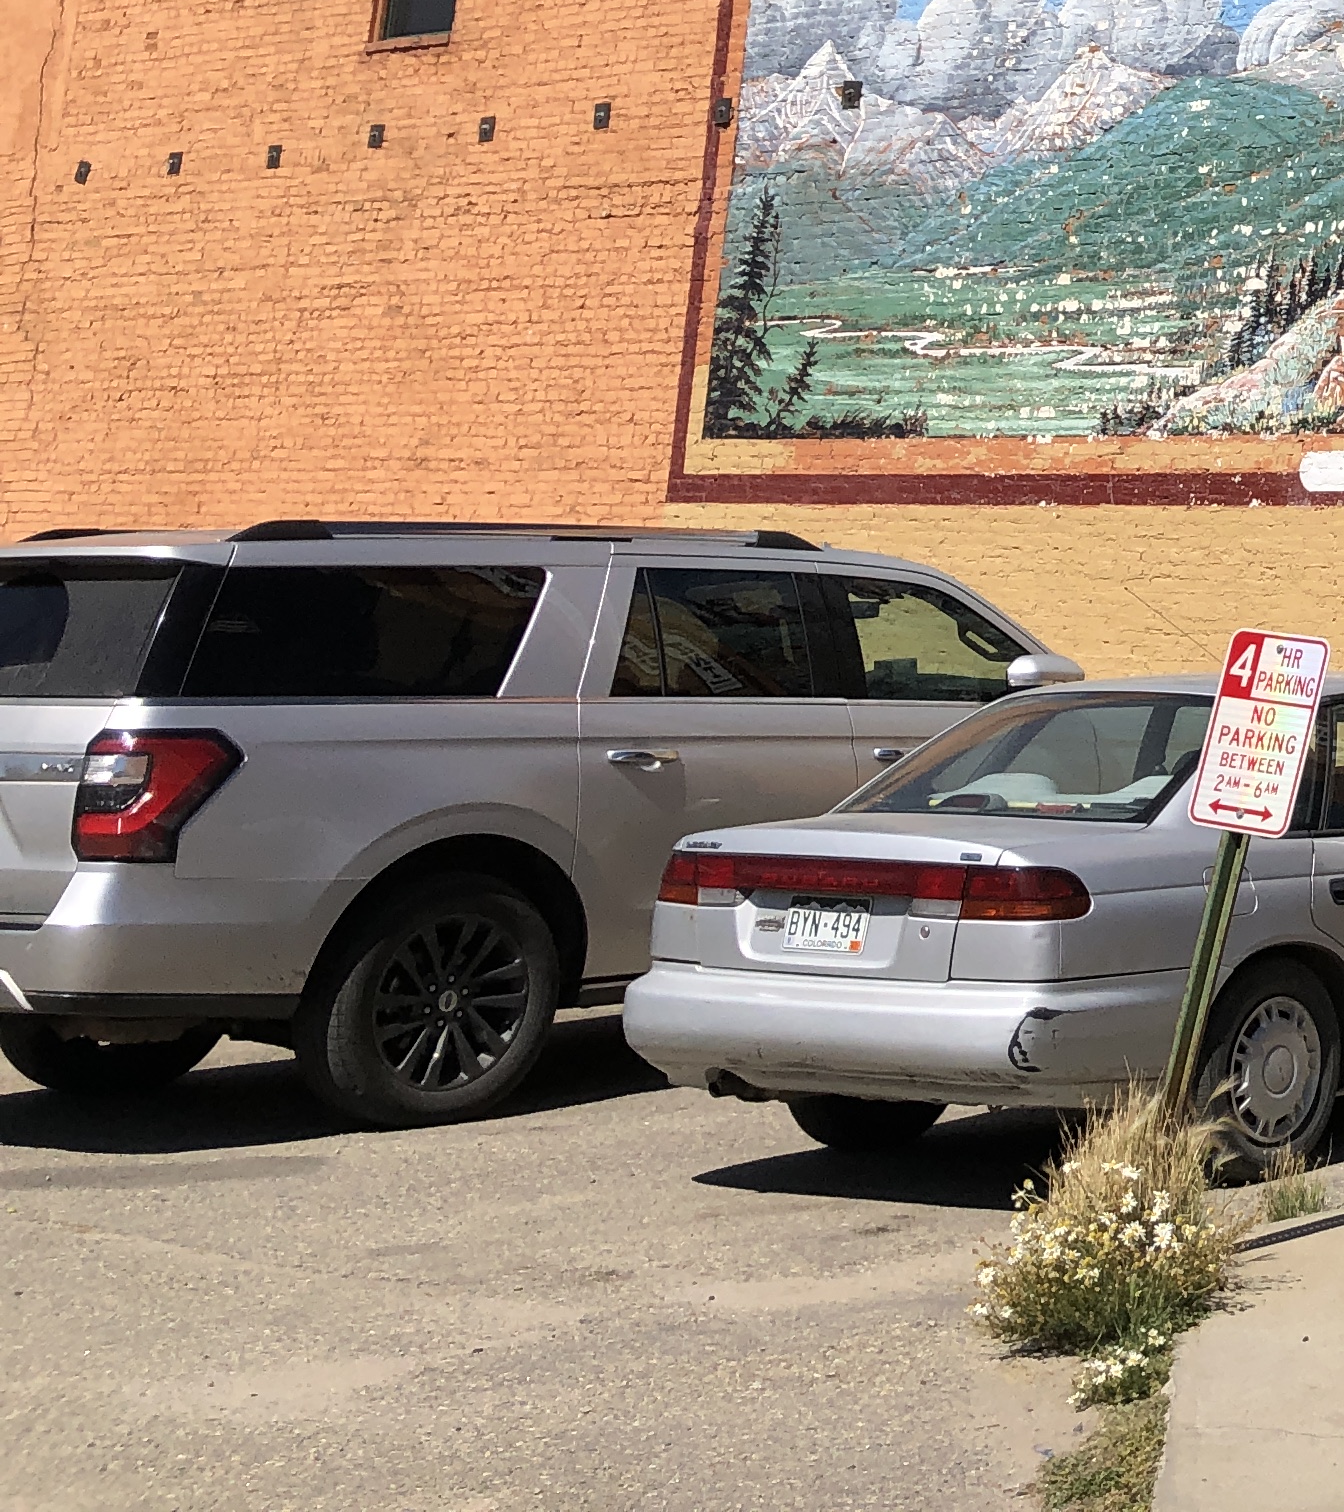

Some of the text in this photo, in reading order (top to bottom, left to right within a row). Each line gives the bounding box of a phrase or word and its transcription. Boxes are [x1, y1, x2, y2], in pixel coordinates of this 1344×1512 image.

[1229, 643, 1304, 688] 4 HR
[1255, 670, 1316, 699] PARKING
[1250, 704, 1277, 726] NO
[1217, 725, 1297, 755] PARKING
[1219, 751, 1285, 776] BETWEEN
[802, 939, 843, 949] COLORADO
